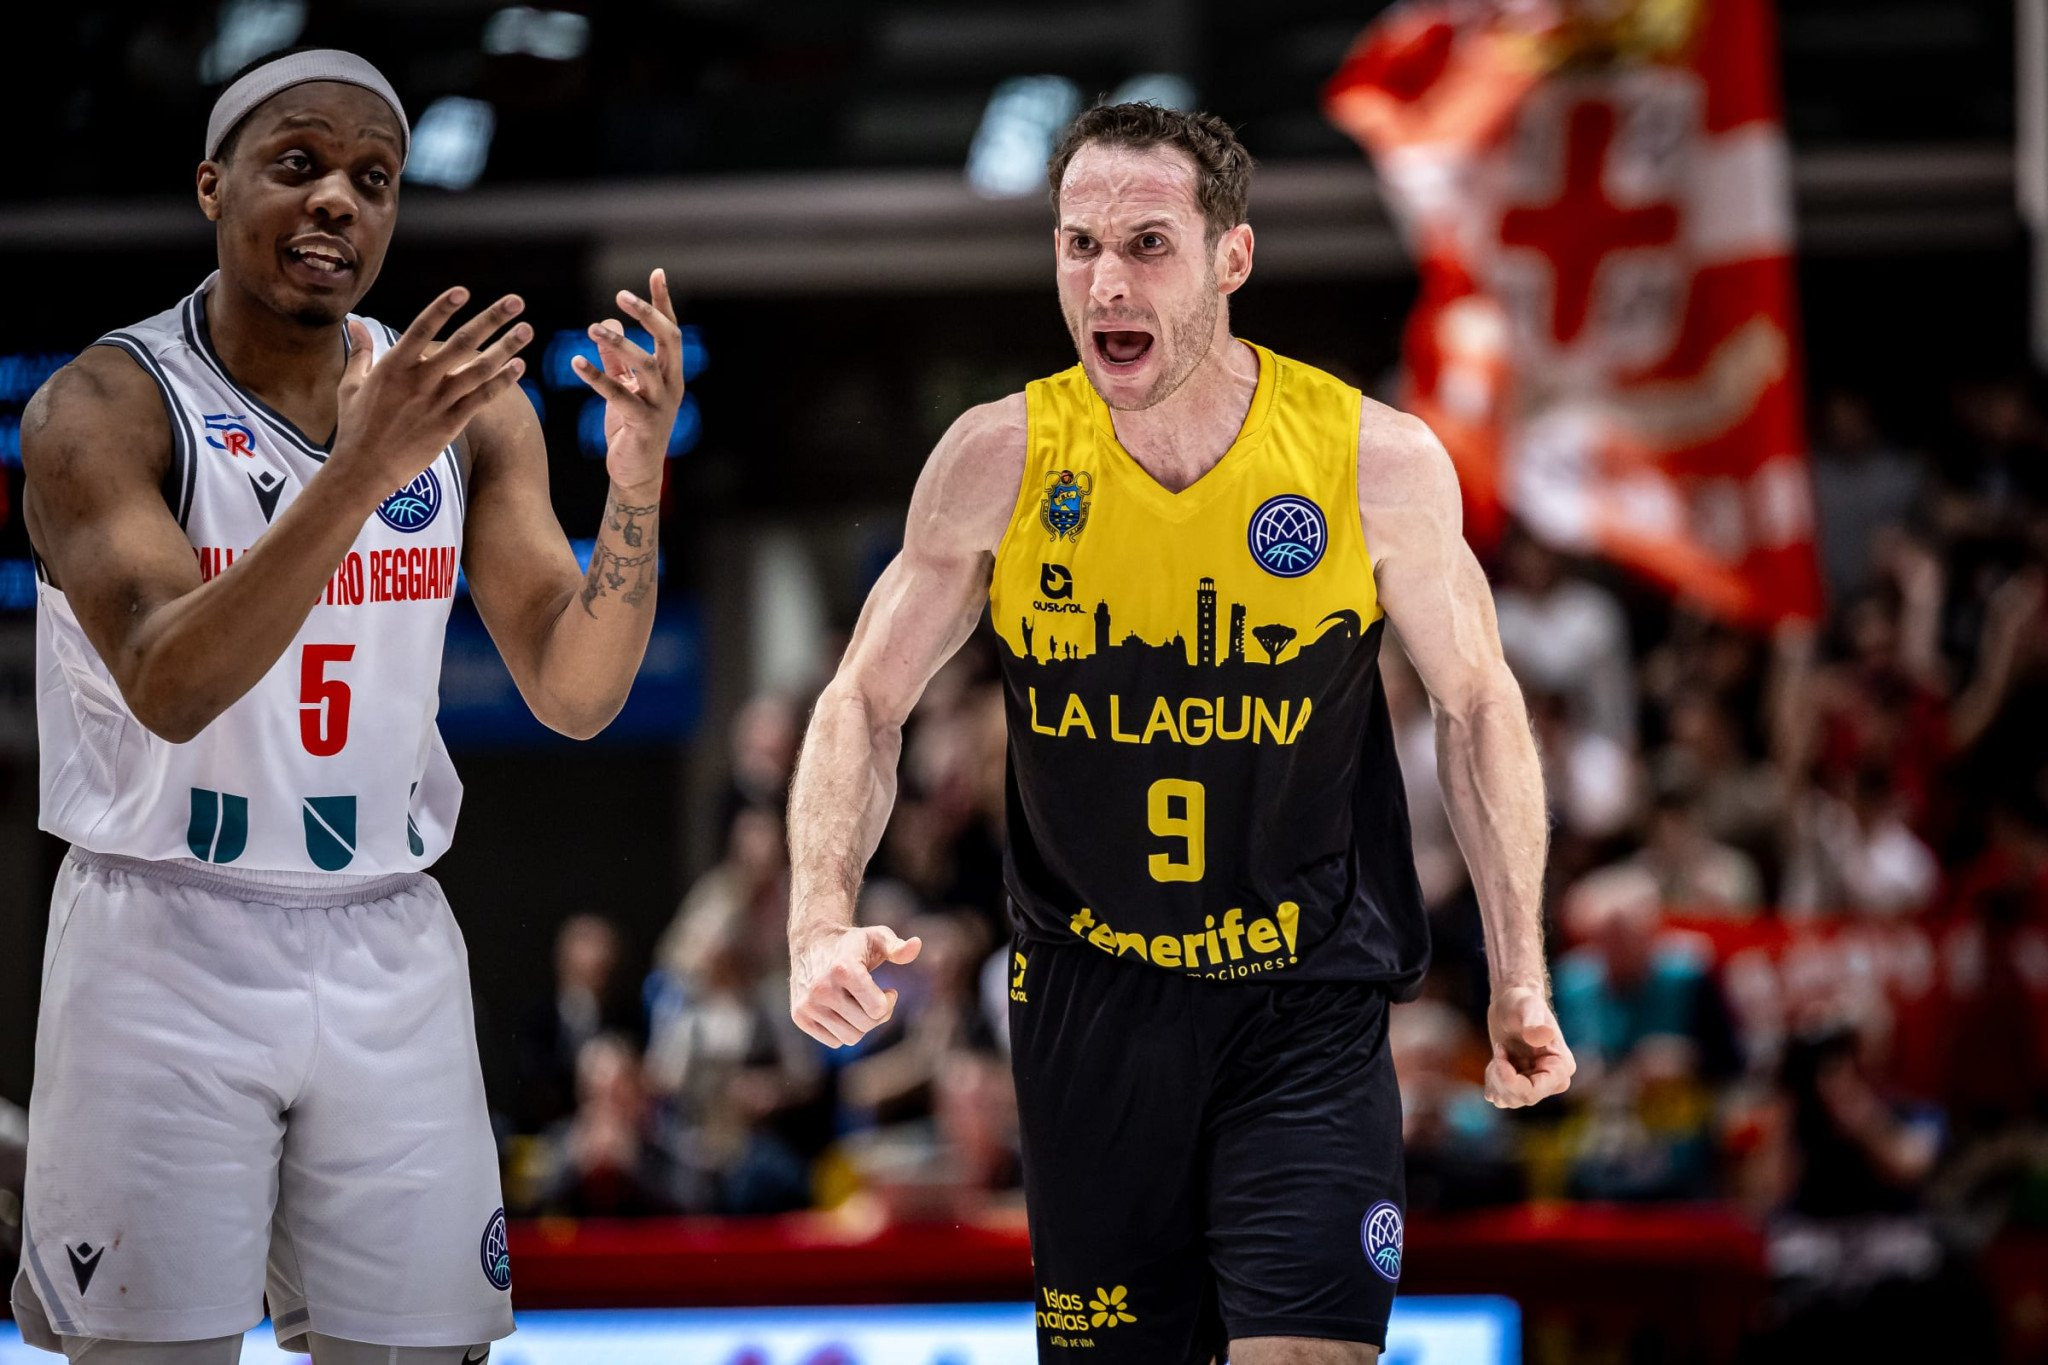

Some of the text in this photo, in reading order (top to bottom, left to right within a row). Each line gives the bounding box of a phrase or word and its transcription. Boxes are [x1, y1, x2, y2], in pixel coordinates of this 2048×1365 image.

[300, 644, 356, 757] 5
[1029, 687, 1312, 746] LA LAGUNA
[1148, 778, 1205, 882] 9
[1036, 1311, 1090, 1331] narias
[1043, 1287, 1083, 1311] Islas
